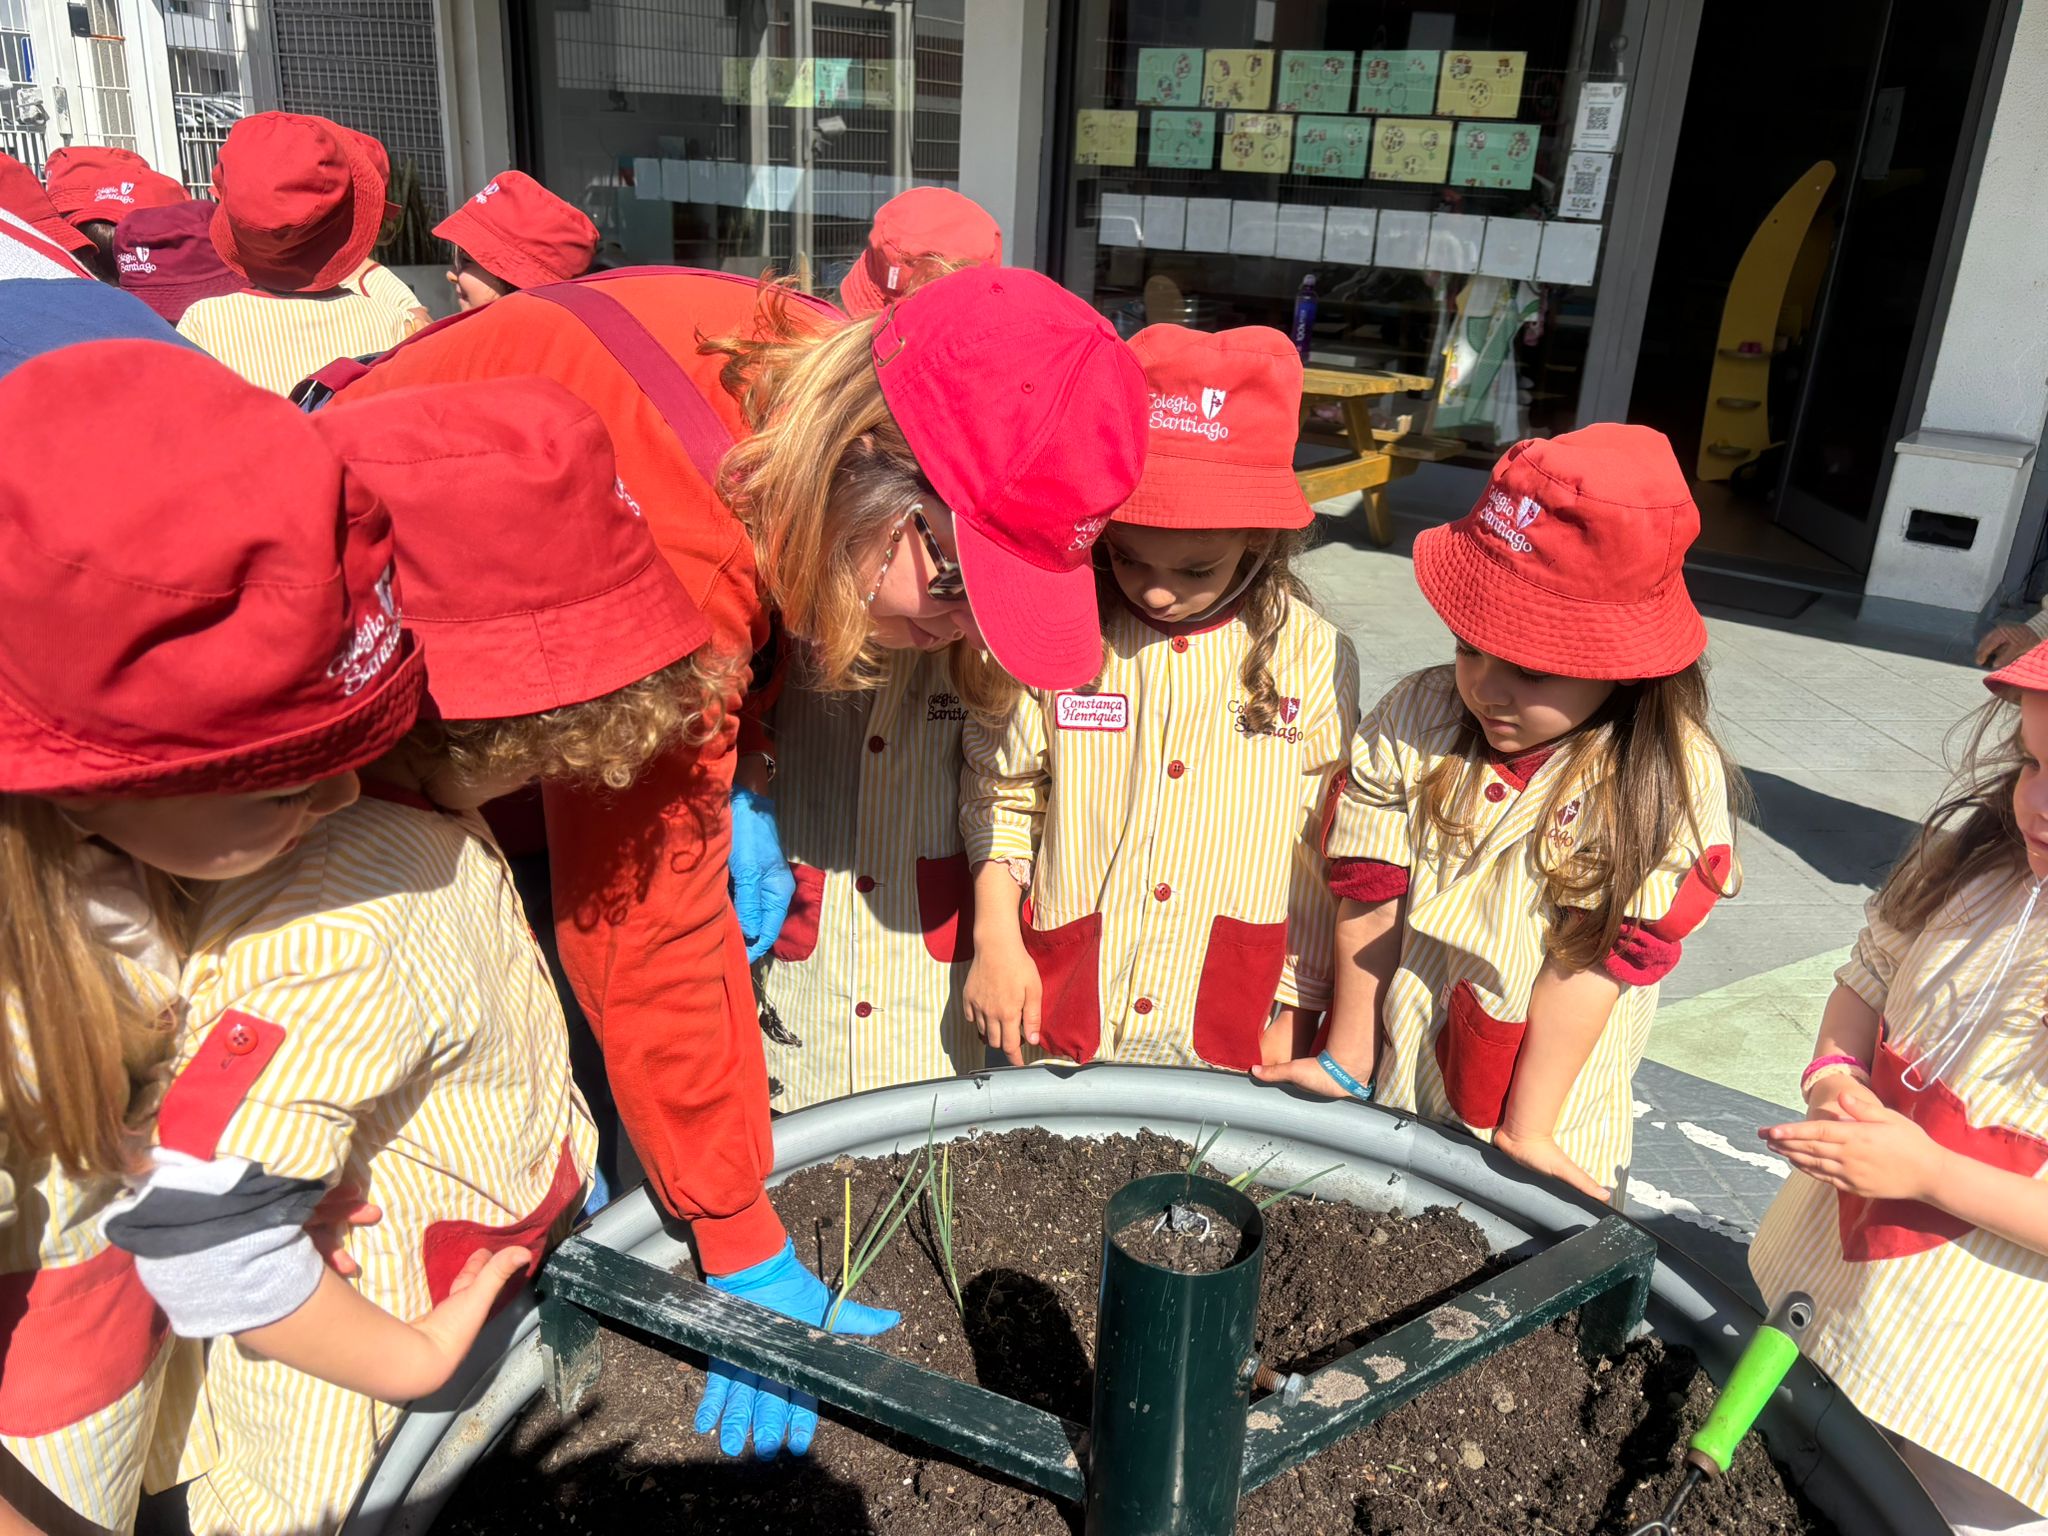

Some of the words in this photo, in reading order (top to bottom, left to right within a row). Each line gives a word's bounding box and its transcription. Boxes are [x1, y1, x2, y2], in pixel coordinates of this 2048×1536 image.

[120, 261, 157, 273] Santiago
[1149, 410, 1229, 442] Santiago
[1480, 502, 1533, 553] Santiago
[1062, 696, 1123, 713] Constança
[1062, 708, 1123, 726] Henriques
